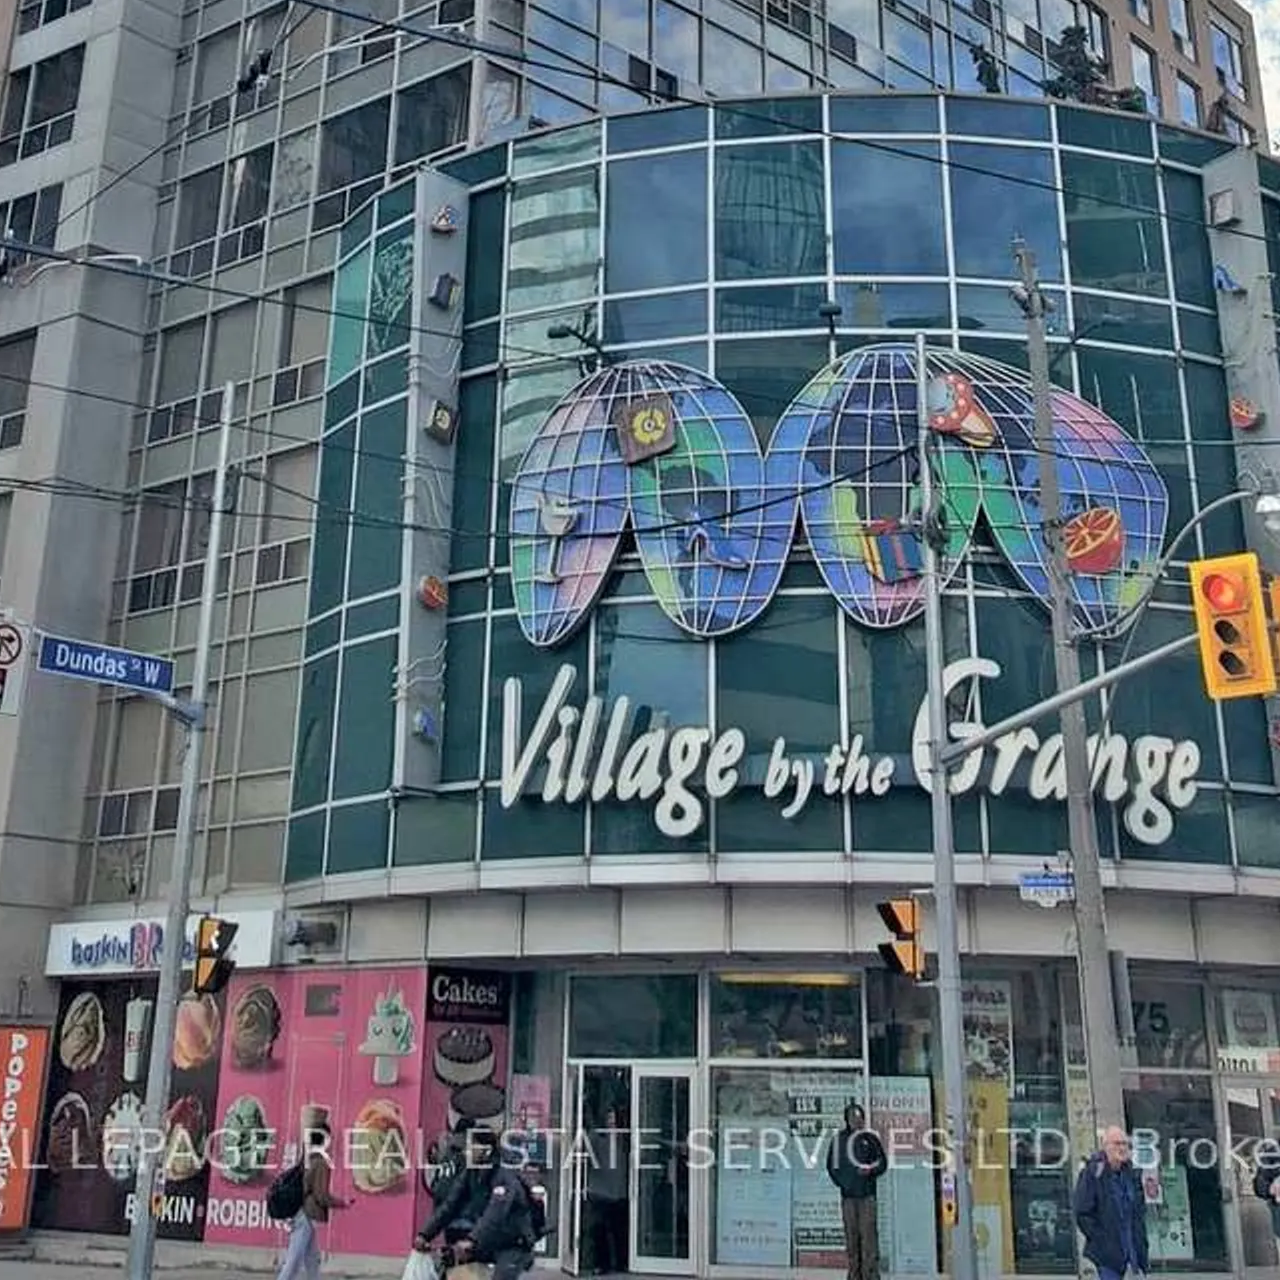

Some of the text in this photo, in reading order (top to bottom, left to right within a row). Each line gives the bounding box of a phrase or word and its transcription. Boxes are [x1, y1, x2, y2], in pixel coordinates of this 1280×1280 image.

[55, 643, 127, 680] Dundas
[143, 663, 161, 685] W
[500, 657, 1200, 846] Village by the Grange
[71, 933, 129, 967] baskin
[432, 974, 498, 1005] Cakes
[124, 1193, 292, 1232] BKIN ROBBI
